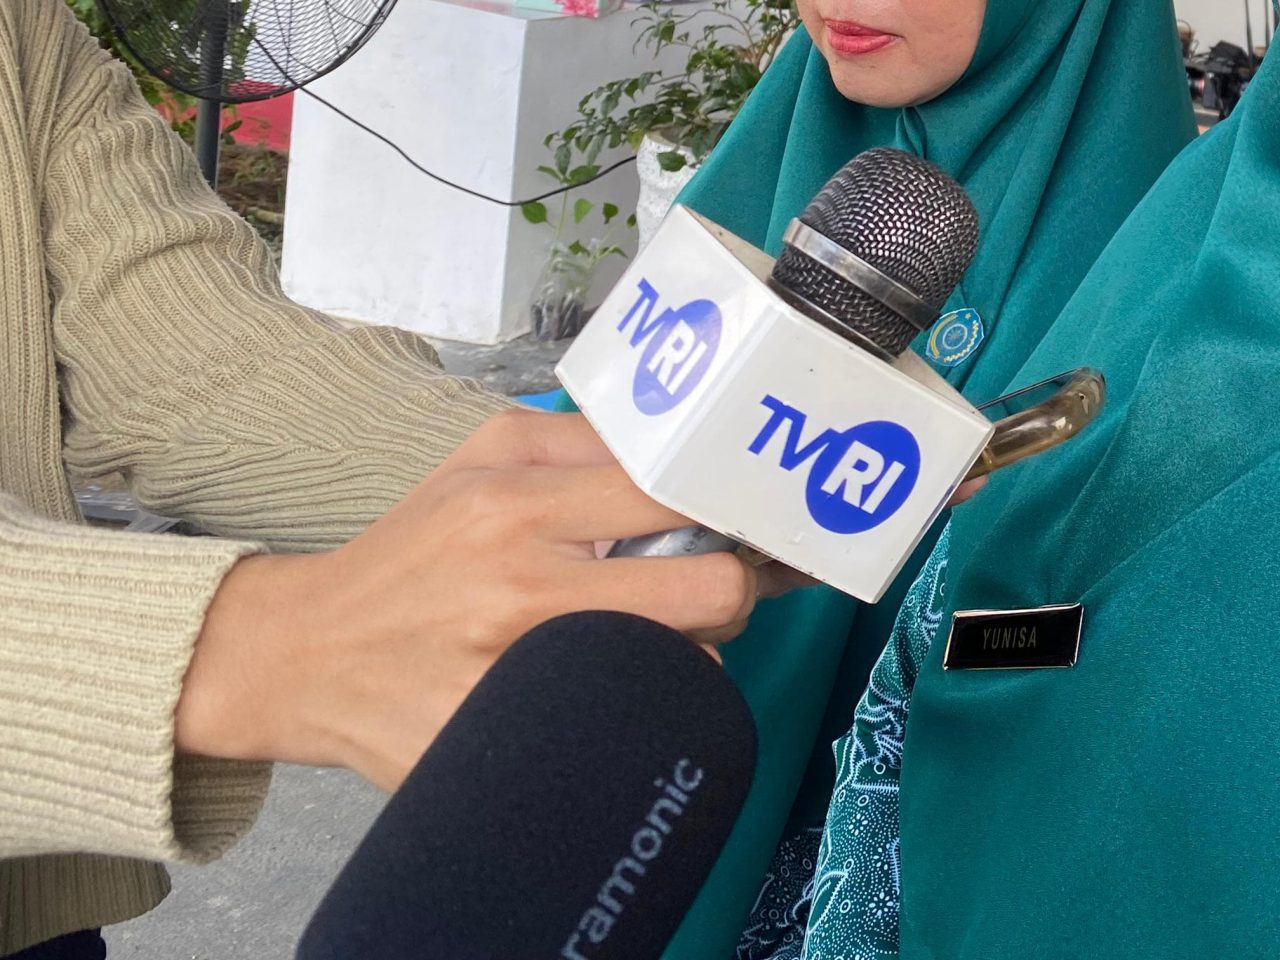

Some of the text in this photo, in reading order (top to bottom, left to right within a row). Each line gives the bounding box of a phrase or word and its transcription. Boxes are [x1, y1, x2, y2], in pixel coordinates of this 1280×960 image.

[616, 276, 708, 397] TVRI
[747, 394, 906, 515] TVRI
[982, 626, 1037, 650] YUNISA
